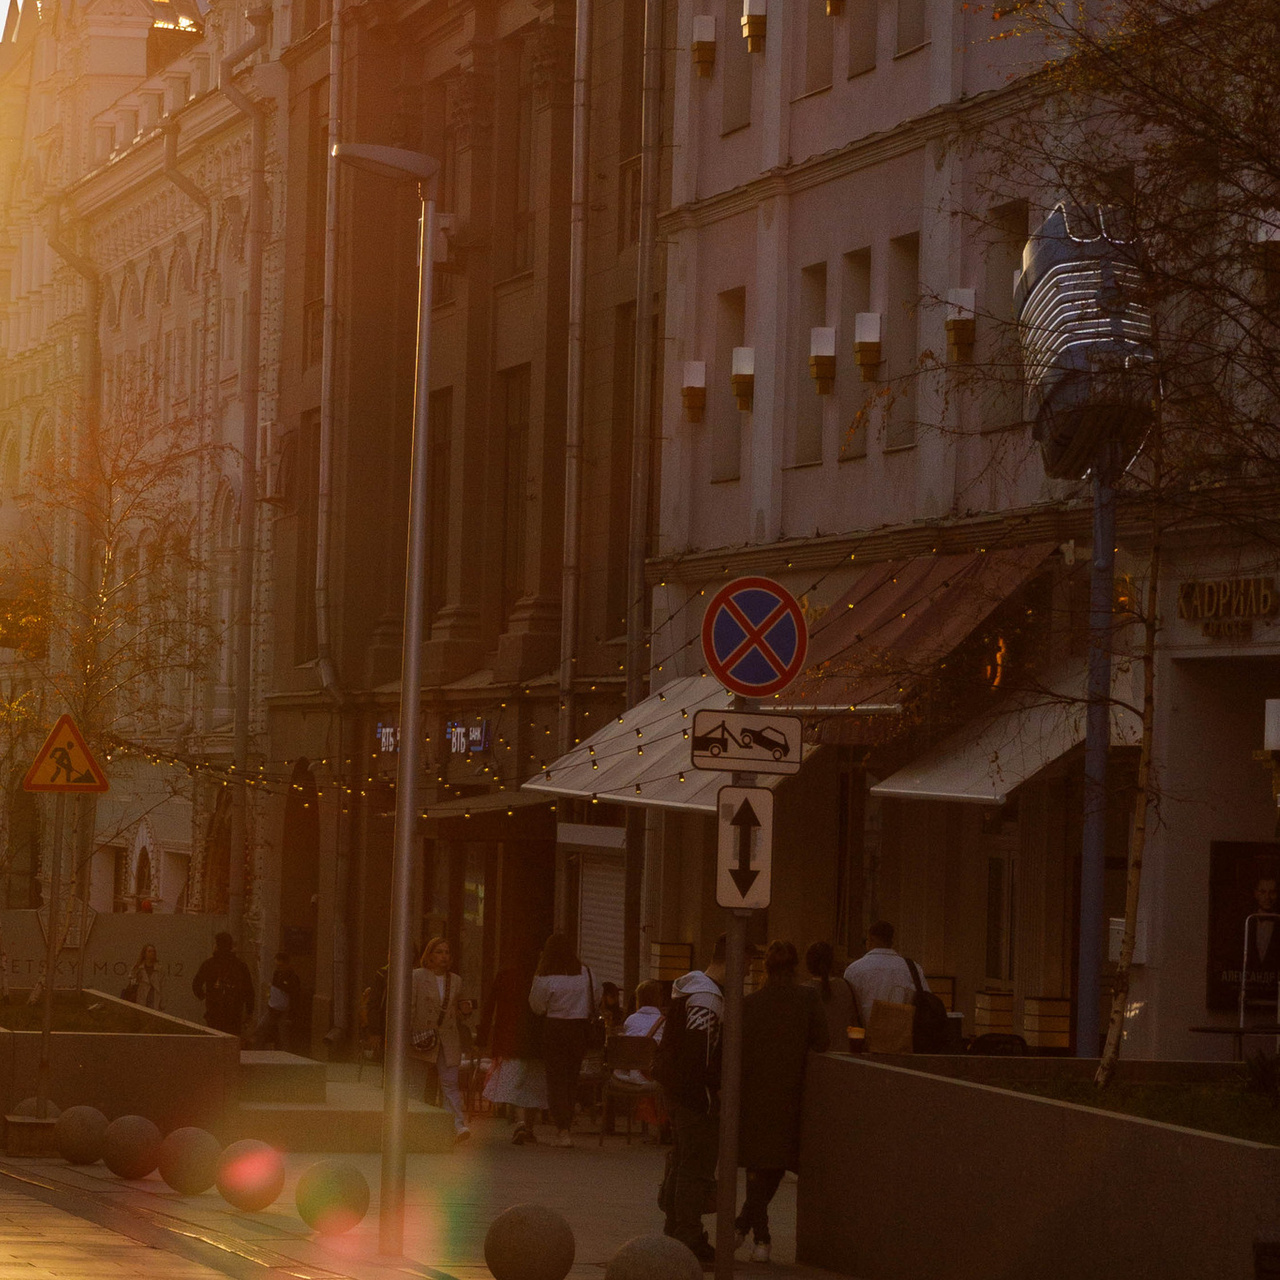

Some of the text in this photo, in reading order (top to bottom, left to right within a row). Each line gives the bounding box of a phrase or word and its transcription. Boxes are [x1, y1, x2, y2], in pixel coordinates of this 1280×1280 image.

[381, 728, 394, 752] ВТБ
[451, 727, 466, 753] ВТБ
[166, 963, 184, 977] 12
